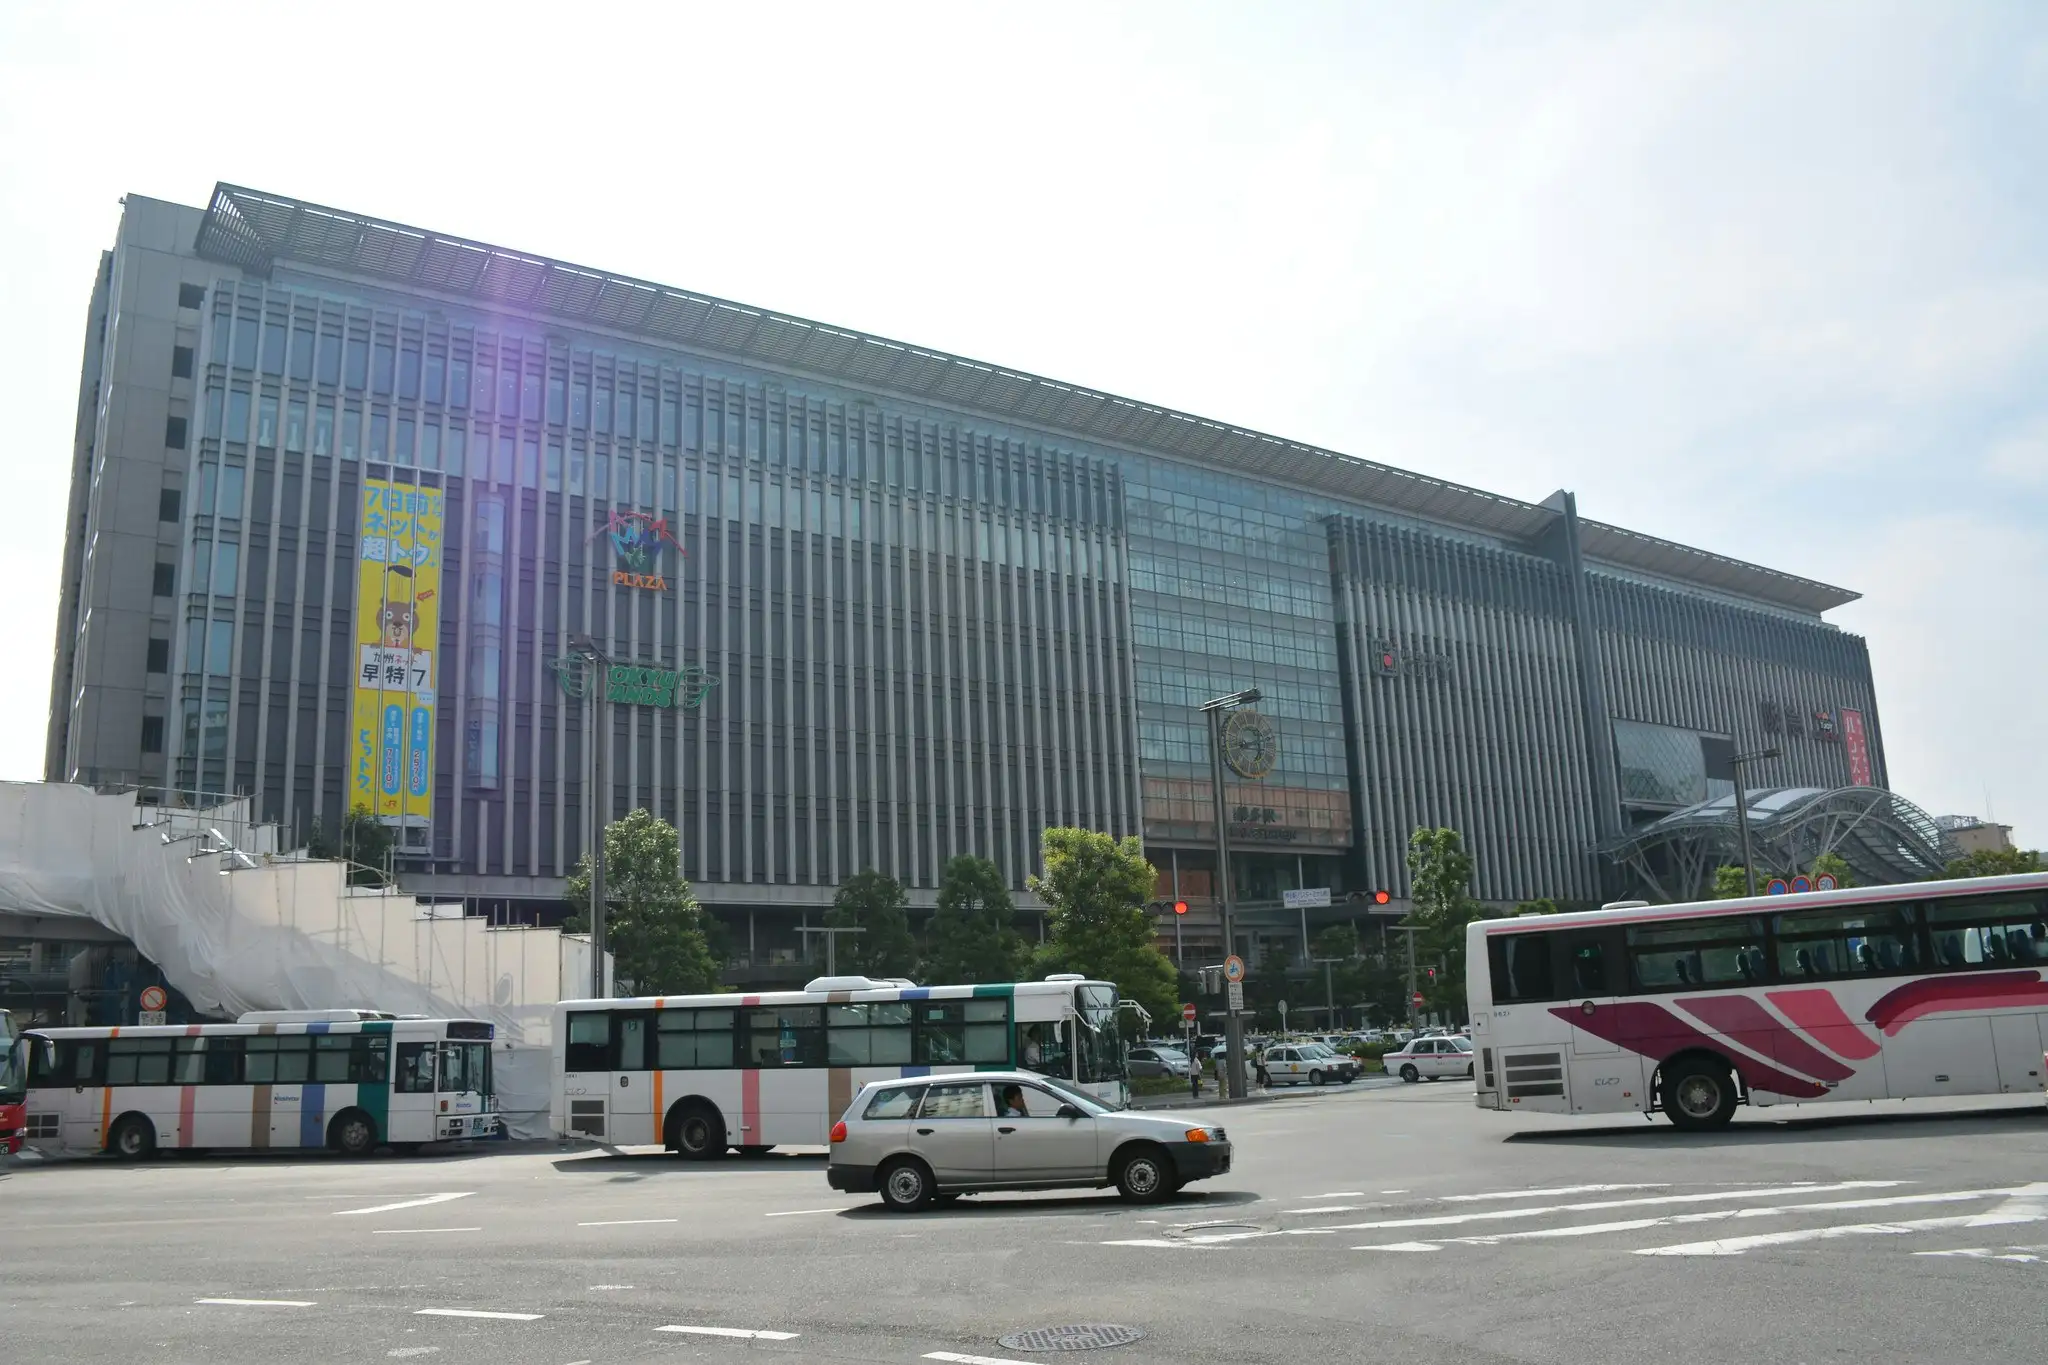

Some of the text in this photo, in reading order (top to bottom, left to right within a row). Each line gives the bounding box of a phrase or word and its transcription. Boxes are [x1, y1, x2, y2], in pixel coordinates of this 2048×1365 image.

[613, 571, 667, 591] PLAZA
[362, 664, 426, 687] 早特7
[606, 665, 677, 689] OKYU
[606, 684, 672, 708] ANDS
